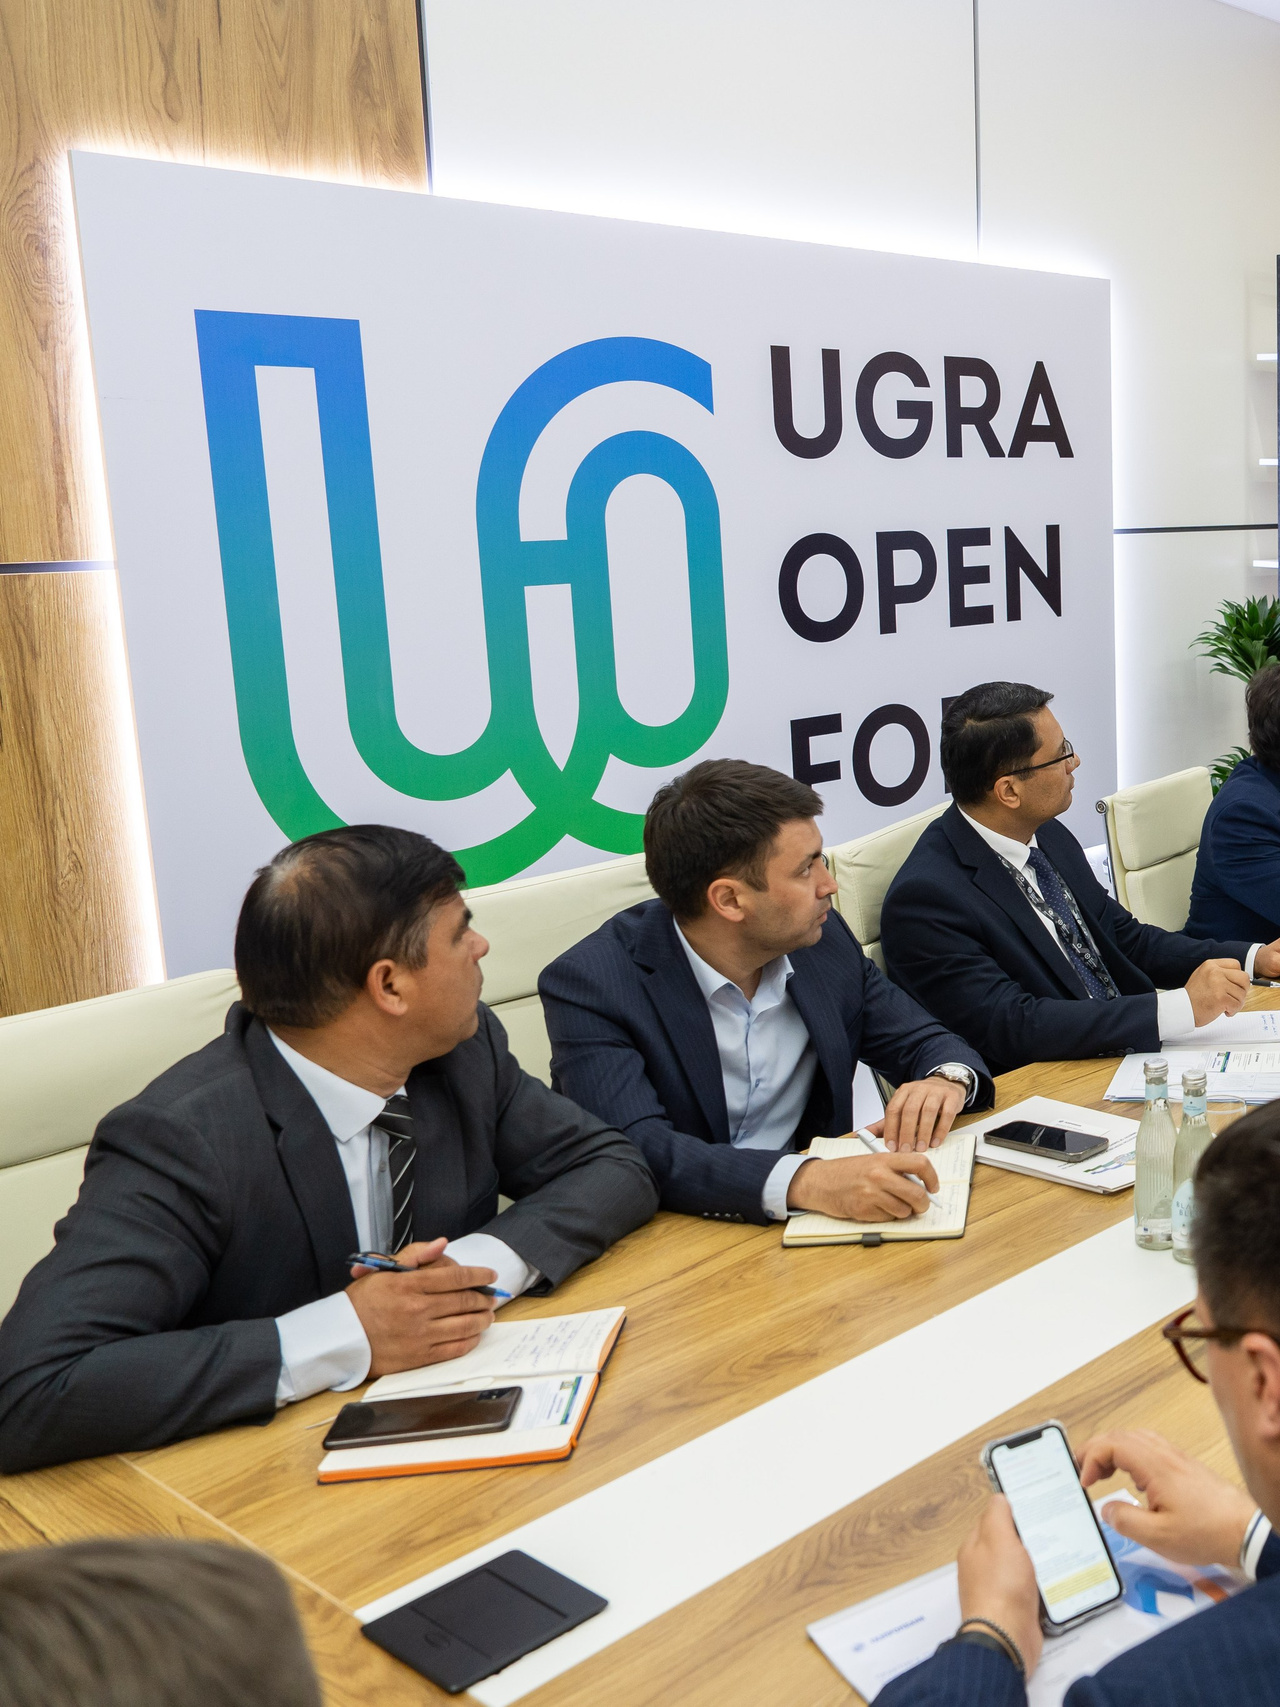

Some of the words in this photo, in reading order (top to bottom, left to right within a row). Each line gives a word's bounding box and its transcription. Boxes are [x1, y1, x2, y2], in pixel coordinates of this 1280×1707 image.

[769, 345, 1074, 460] UGRA
[778, 523, 1063, 642] OPEN
[790, 695, 962, 807] FO
